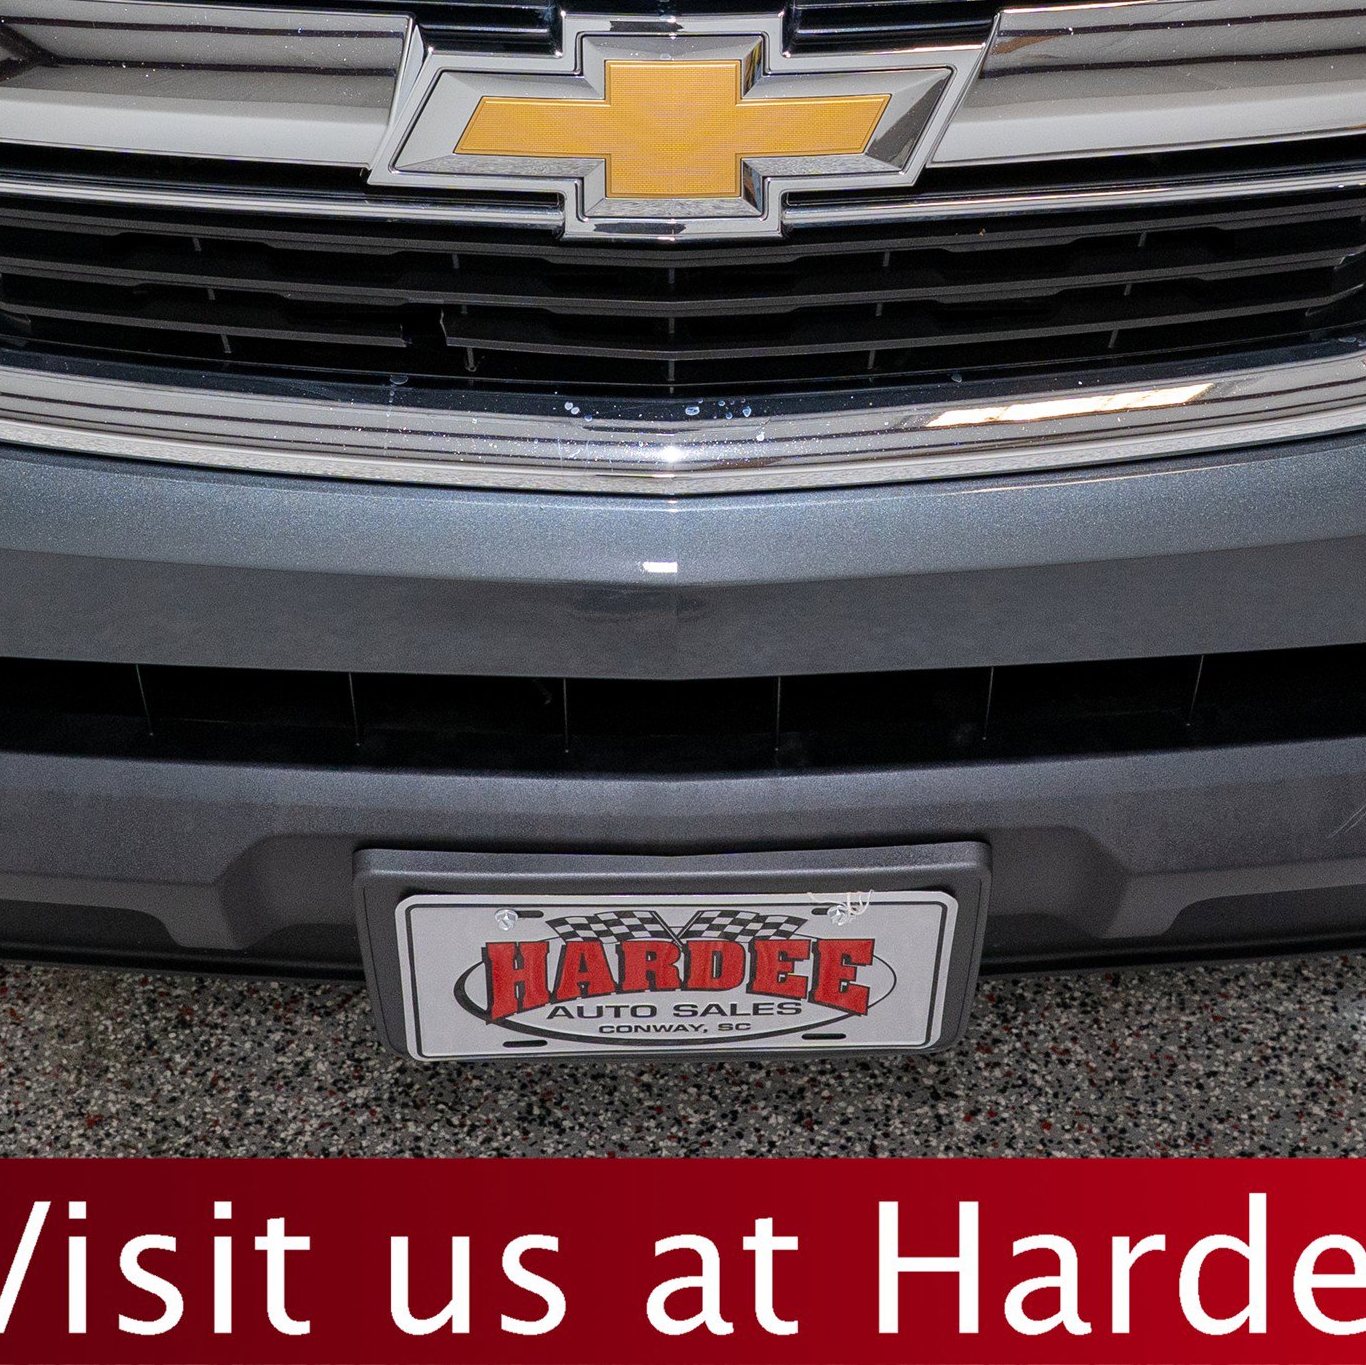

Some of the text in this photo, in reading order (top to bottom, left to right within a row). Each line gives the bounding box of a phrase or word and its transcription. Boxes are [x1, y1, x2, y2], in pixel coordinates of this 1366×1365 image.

[483, 938, 875, 1024] HARDEE
[546, 1001, 803, 1020] AUTO SALES
[598, 1022, 752, 1034] CONWAY, SC
